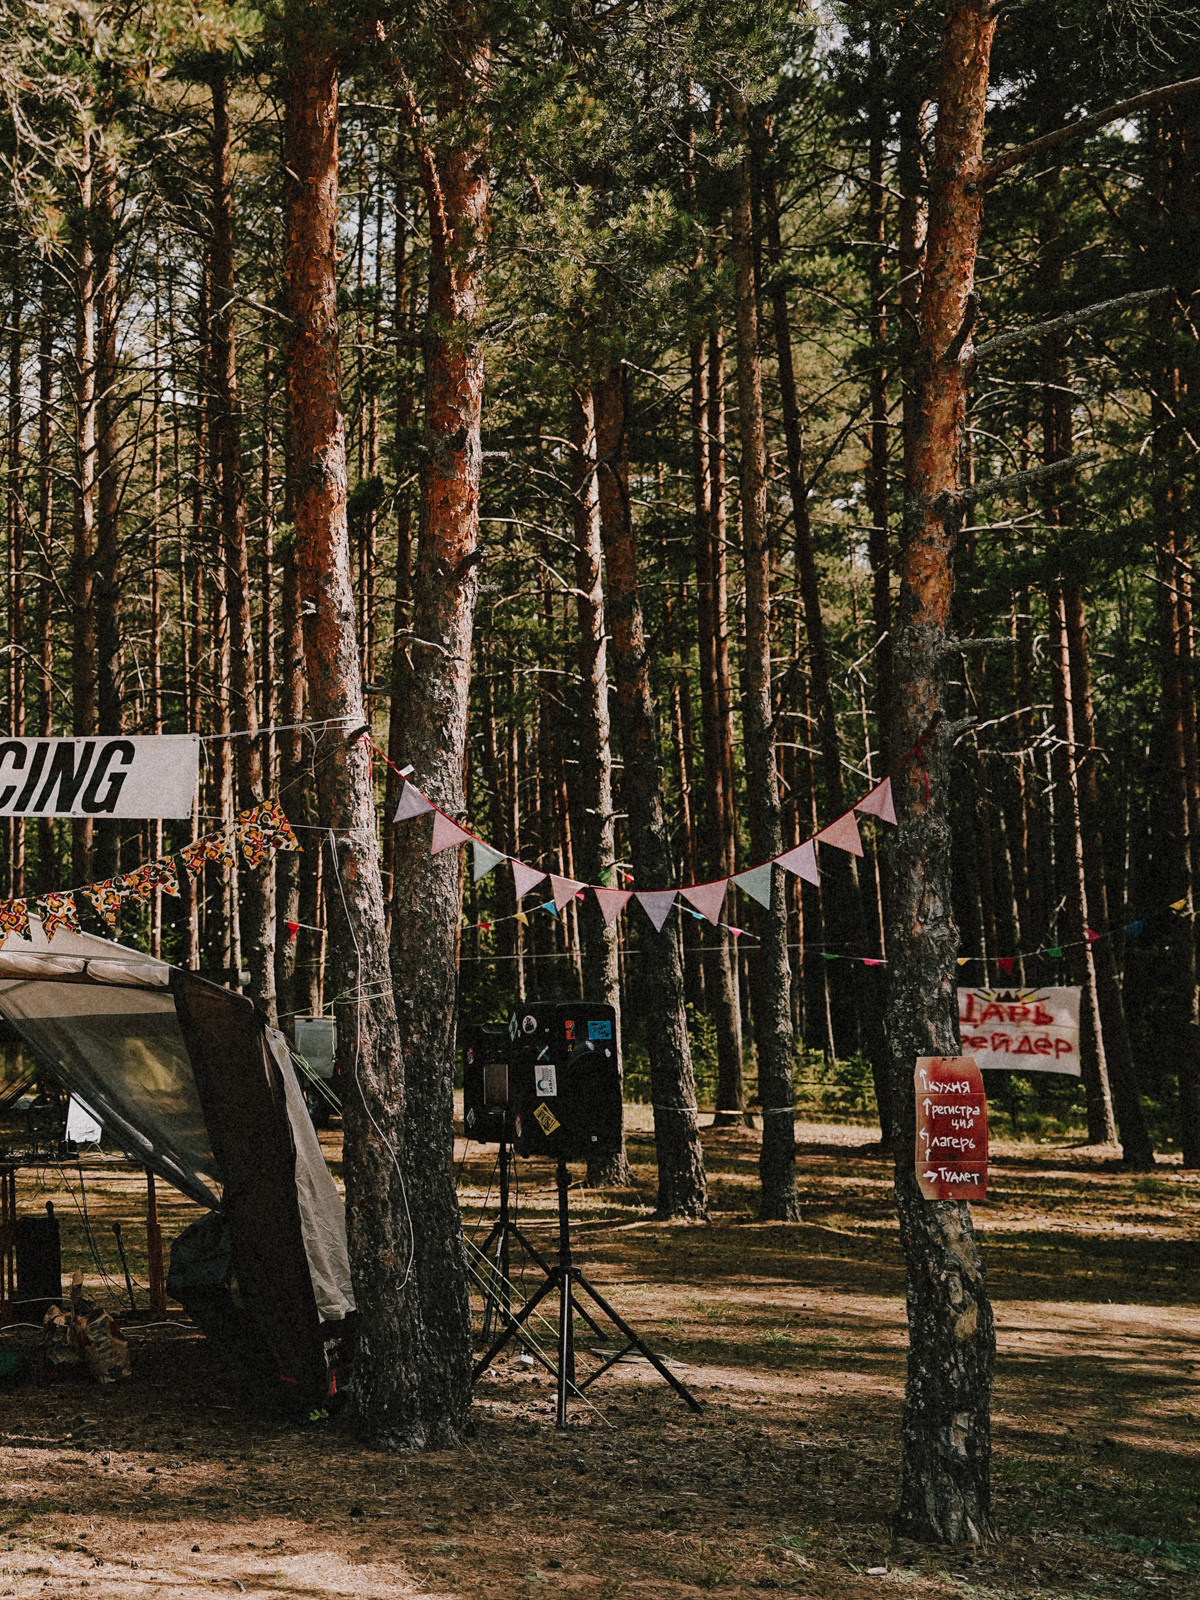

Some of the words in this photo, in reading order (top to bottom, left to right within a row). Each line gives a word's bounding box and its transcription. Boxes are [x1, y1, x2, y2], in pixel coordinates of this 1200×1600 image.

[931, 1104, 981, 1120] регистра
[951, 1118, 974, 1131] ция
[931, 1136, 976, 1152] лагерь
